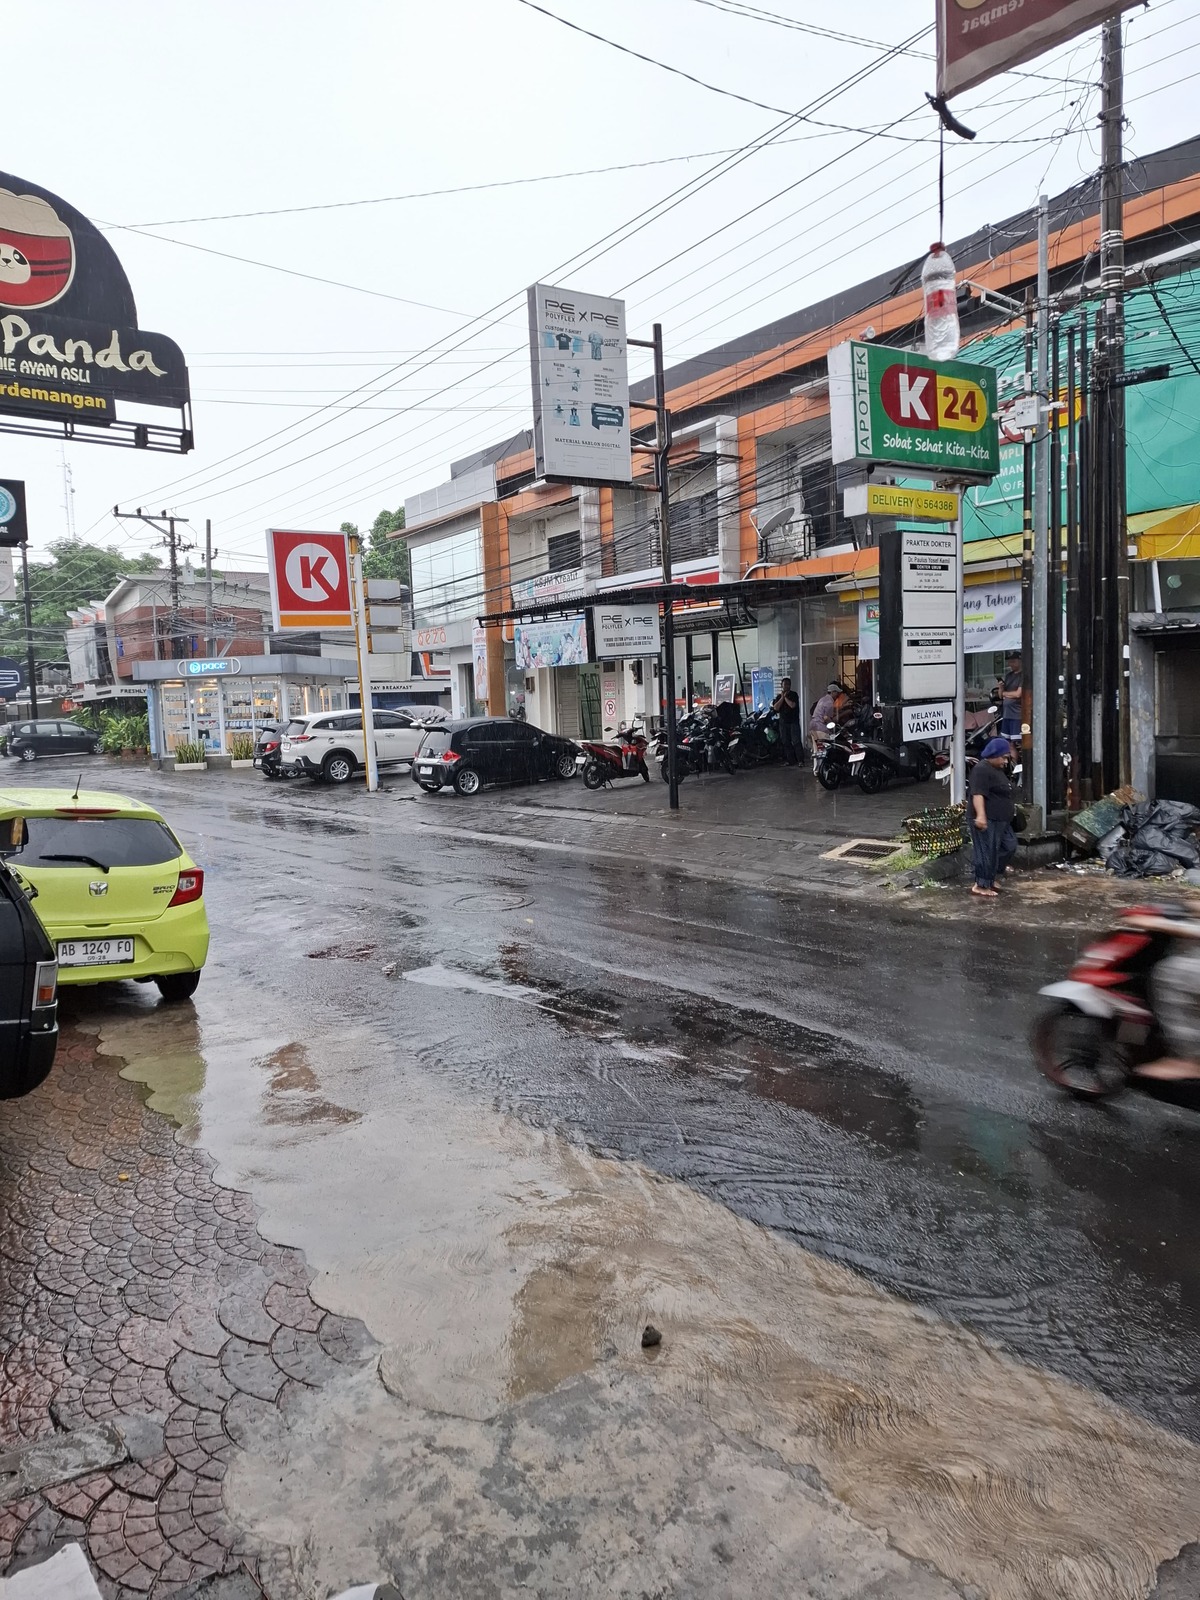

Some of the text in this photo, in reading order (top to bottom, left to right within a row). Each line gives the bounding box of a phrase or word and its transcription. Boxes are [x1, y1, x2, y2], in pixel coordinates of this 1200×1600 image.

[545, 312, 575, 323] POLYFLEX
[1, 315, 168, 377] Panda
[20, 360, 58, 378] AYAM
[61, 368, 91, 383] ASLI
[856, 350, 871, 450] APOTEK
[555, 437, 581, 445] MATERIAL
[883, 433, 990, 460] Sobat Sehat Kita-Kita
[872, 494, 954, 512] DELIVERY 564386
[906, 539, 952, 548] PRAKTEK DOKTER
[985, 593, 1016, 608] Tahun
[1000, 623, 1012, 632] gula
[910, 710, 944, 721] MELAYANI
[908, 719, 948, 734] VAKSIN
[61, 944, 76, 957] AB
[82, 942, 111, 956] 1249
